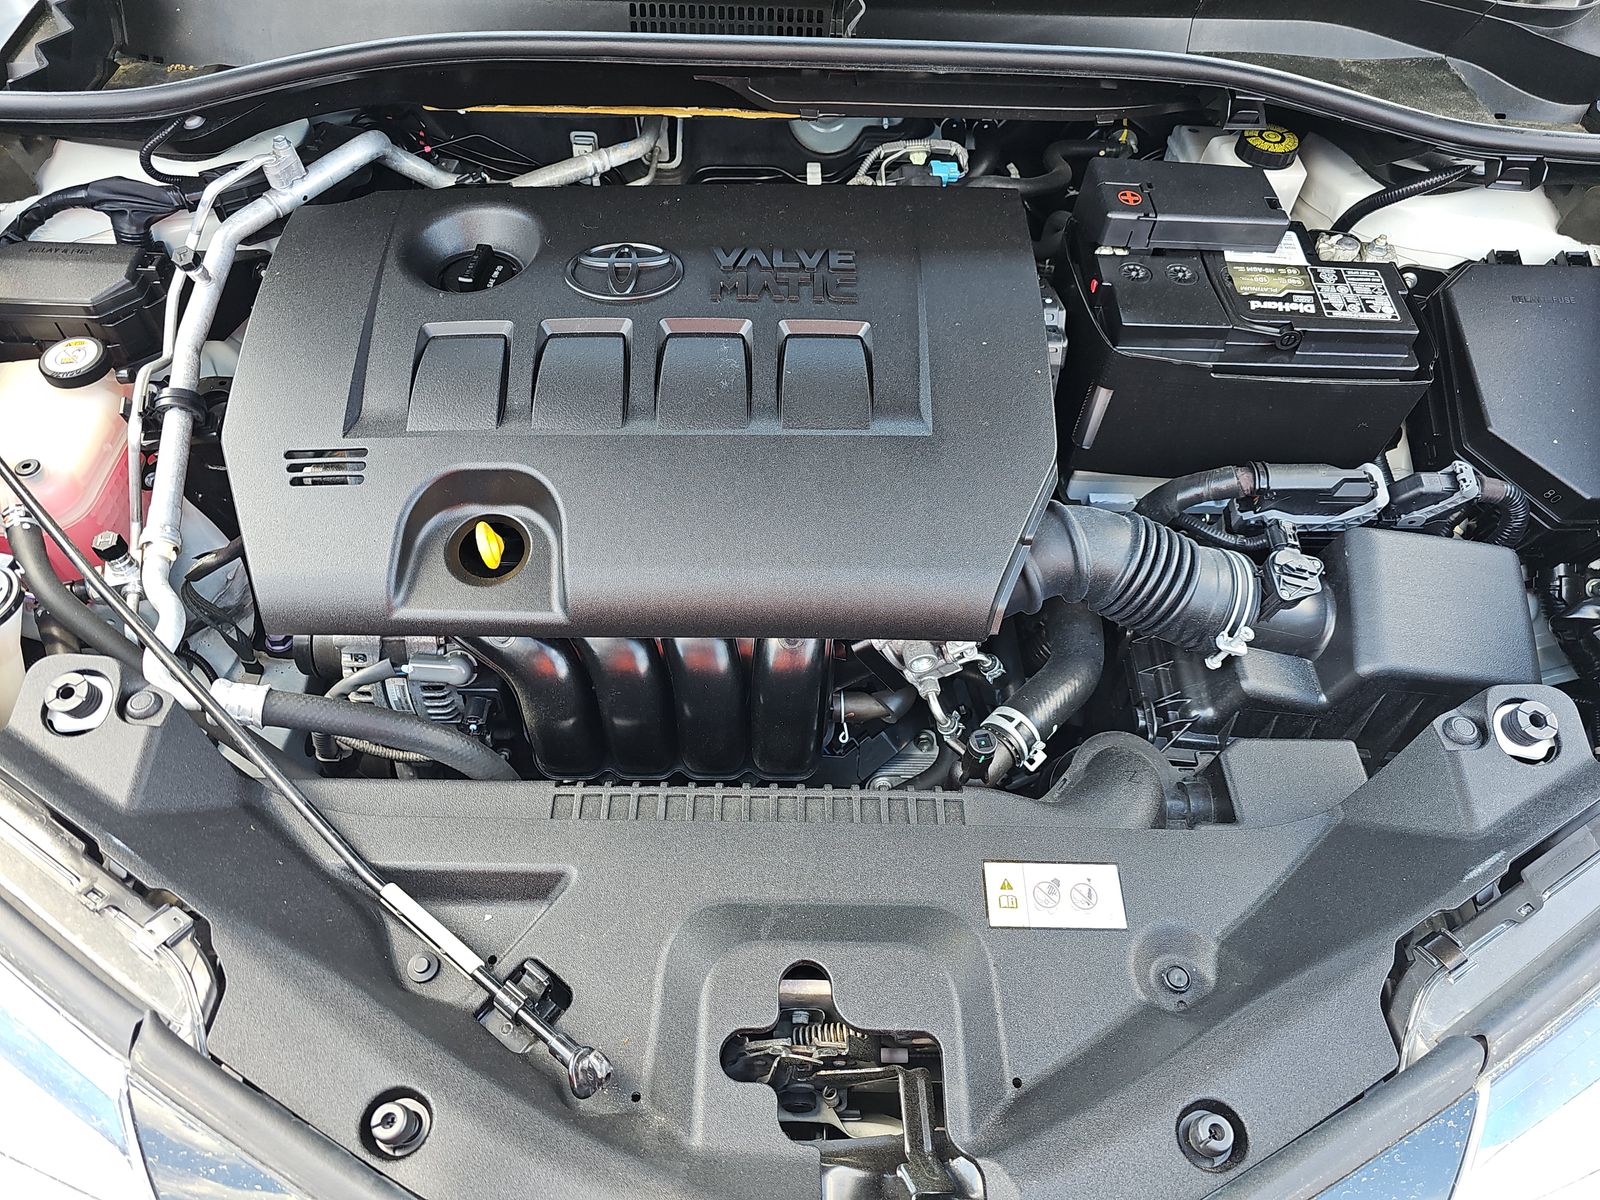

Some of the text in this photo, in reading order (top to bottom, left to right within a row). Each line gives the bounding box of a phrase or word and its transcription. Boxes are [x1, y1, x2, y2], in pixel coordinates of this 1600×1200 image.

[712, 246, 857, 272] VALVE
[486, 278, 496, 288] SAE
[710, 272, 858, 304] MATIC
[1239, 285, 1278, 293] PLATINUM
[1551, 295, 1577, 304] FUSE
[1249, 300, 1316, 314] DieHard
[1543, 489, 1562, 503] 80
